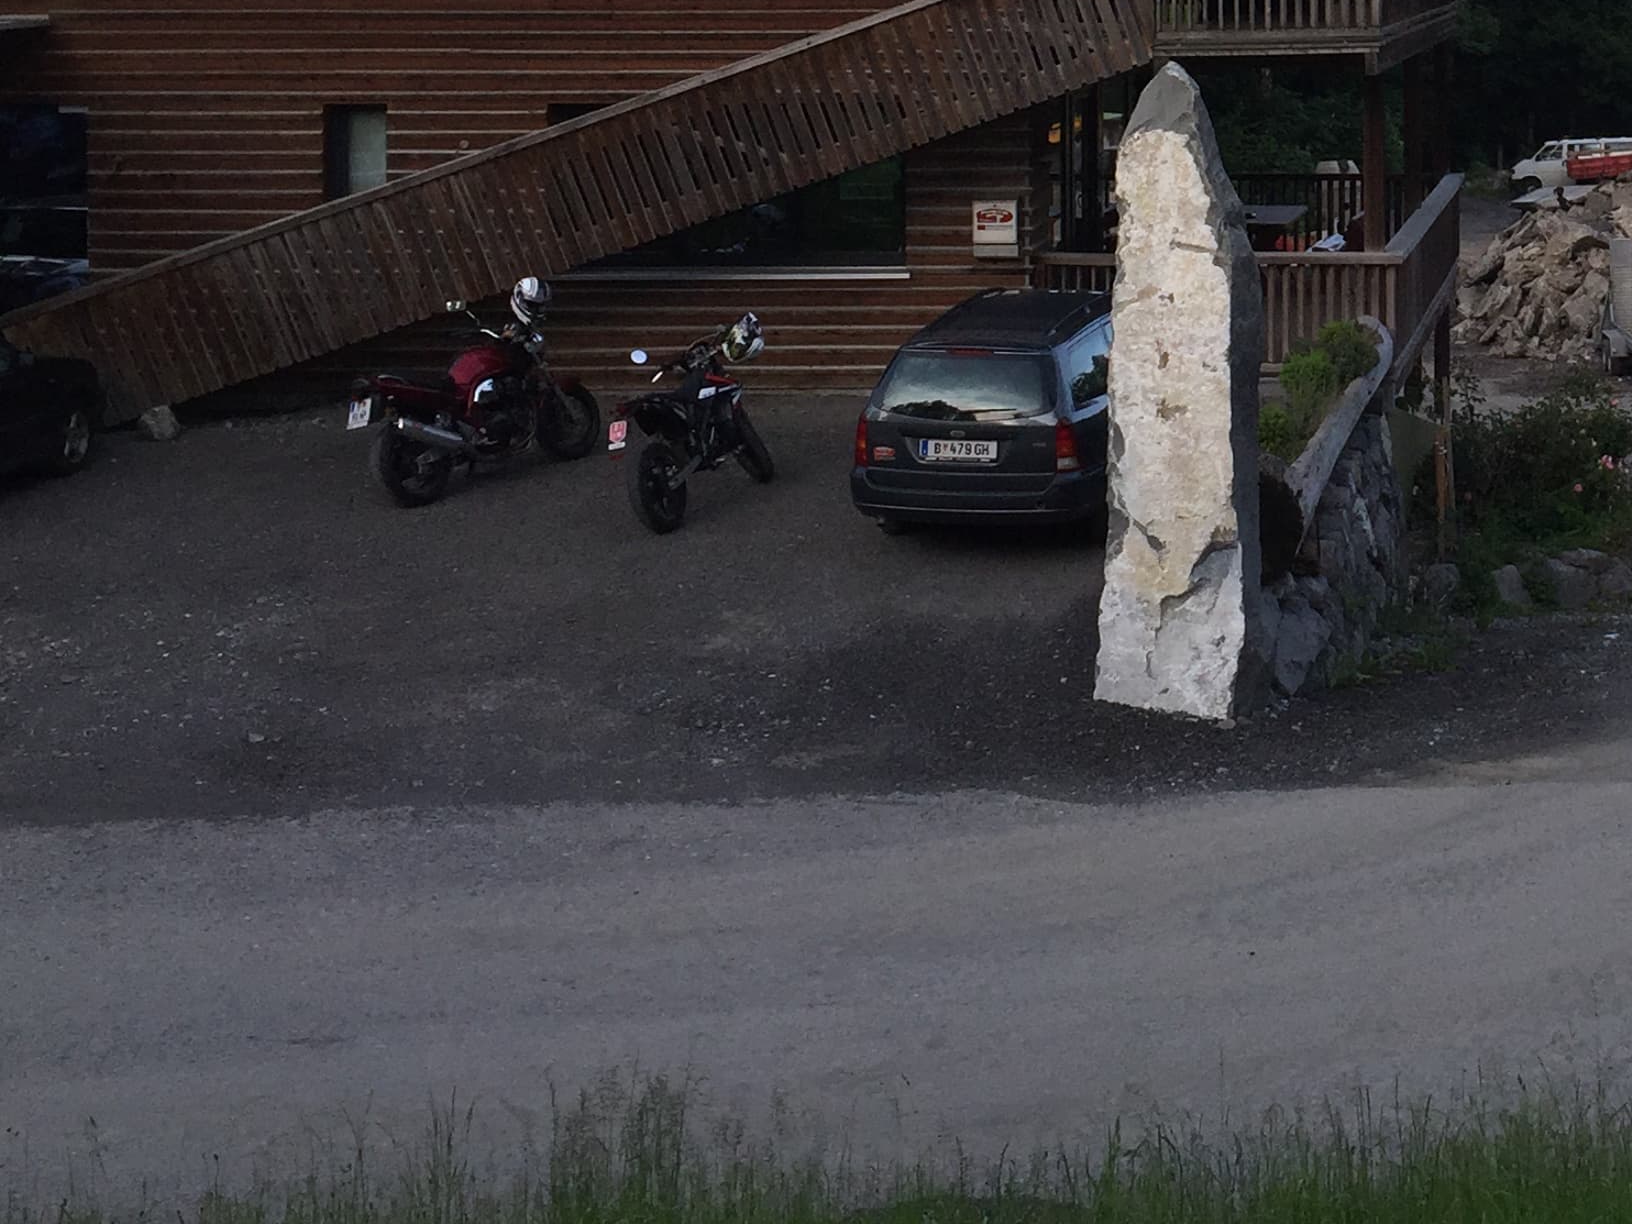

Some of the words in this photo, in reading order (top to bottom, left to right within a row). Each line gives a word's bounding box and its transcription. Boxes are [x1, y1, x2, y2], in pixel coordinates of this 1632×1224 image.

[934, 442, 941, 454] B
[949, 442, 972, 456] 479
[974, 443, 990, 456] GH
